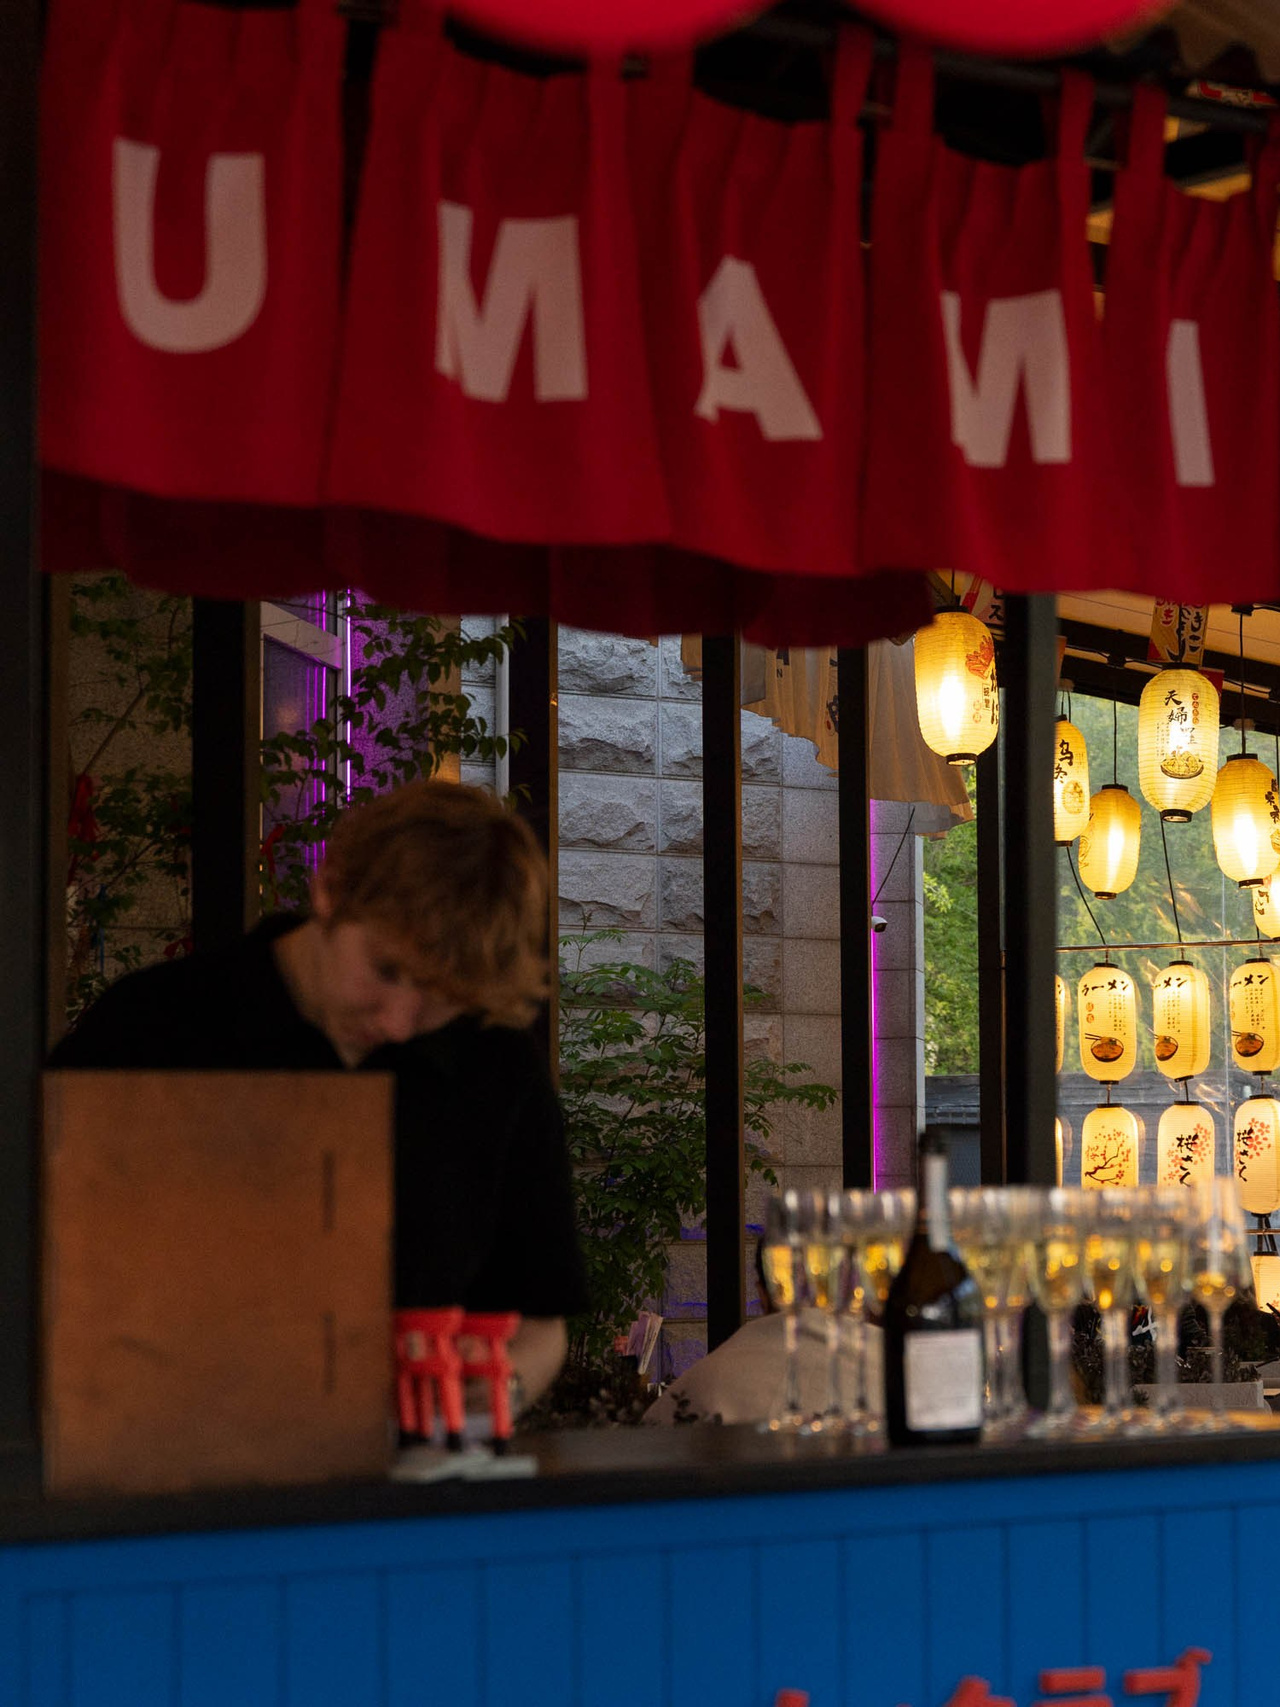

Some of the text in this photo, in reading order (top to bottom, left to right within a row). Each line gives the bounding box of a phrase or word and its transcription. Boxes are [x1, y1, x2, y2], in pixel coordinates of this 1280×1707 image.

[112, 138, 1215, 487] UMAMI
[1081, 979, 1130, 997] ラーメン
